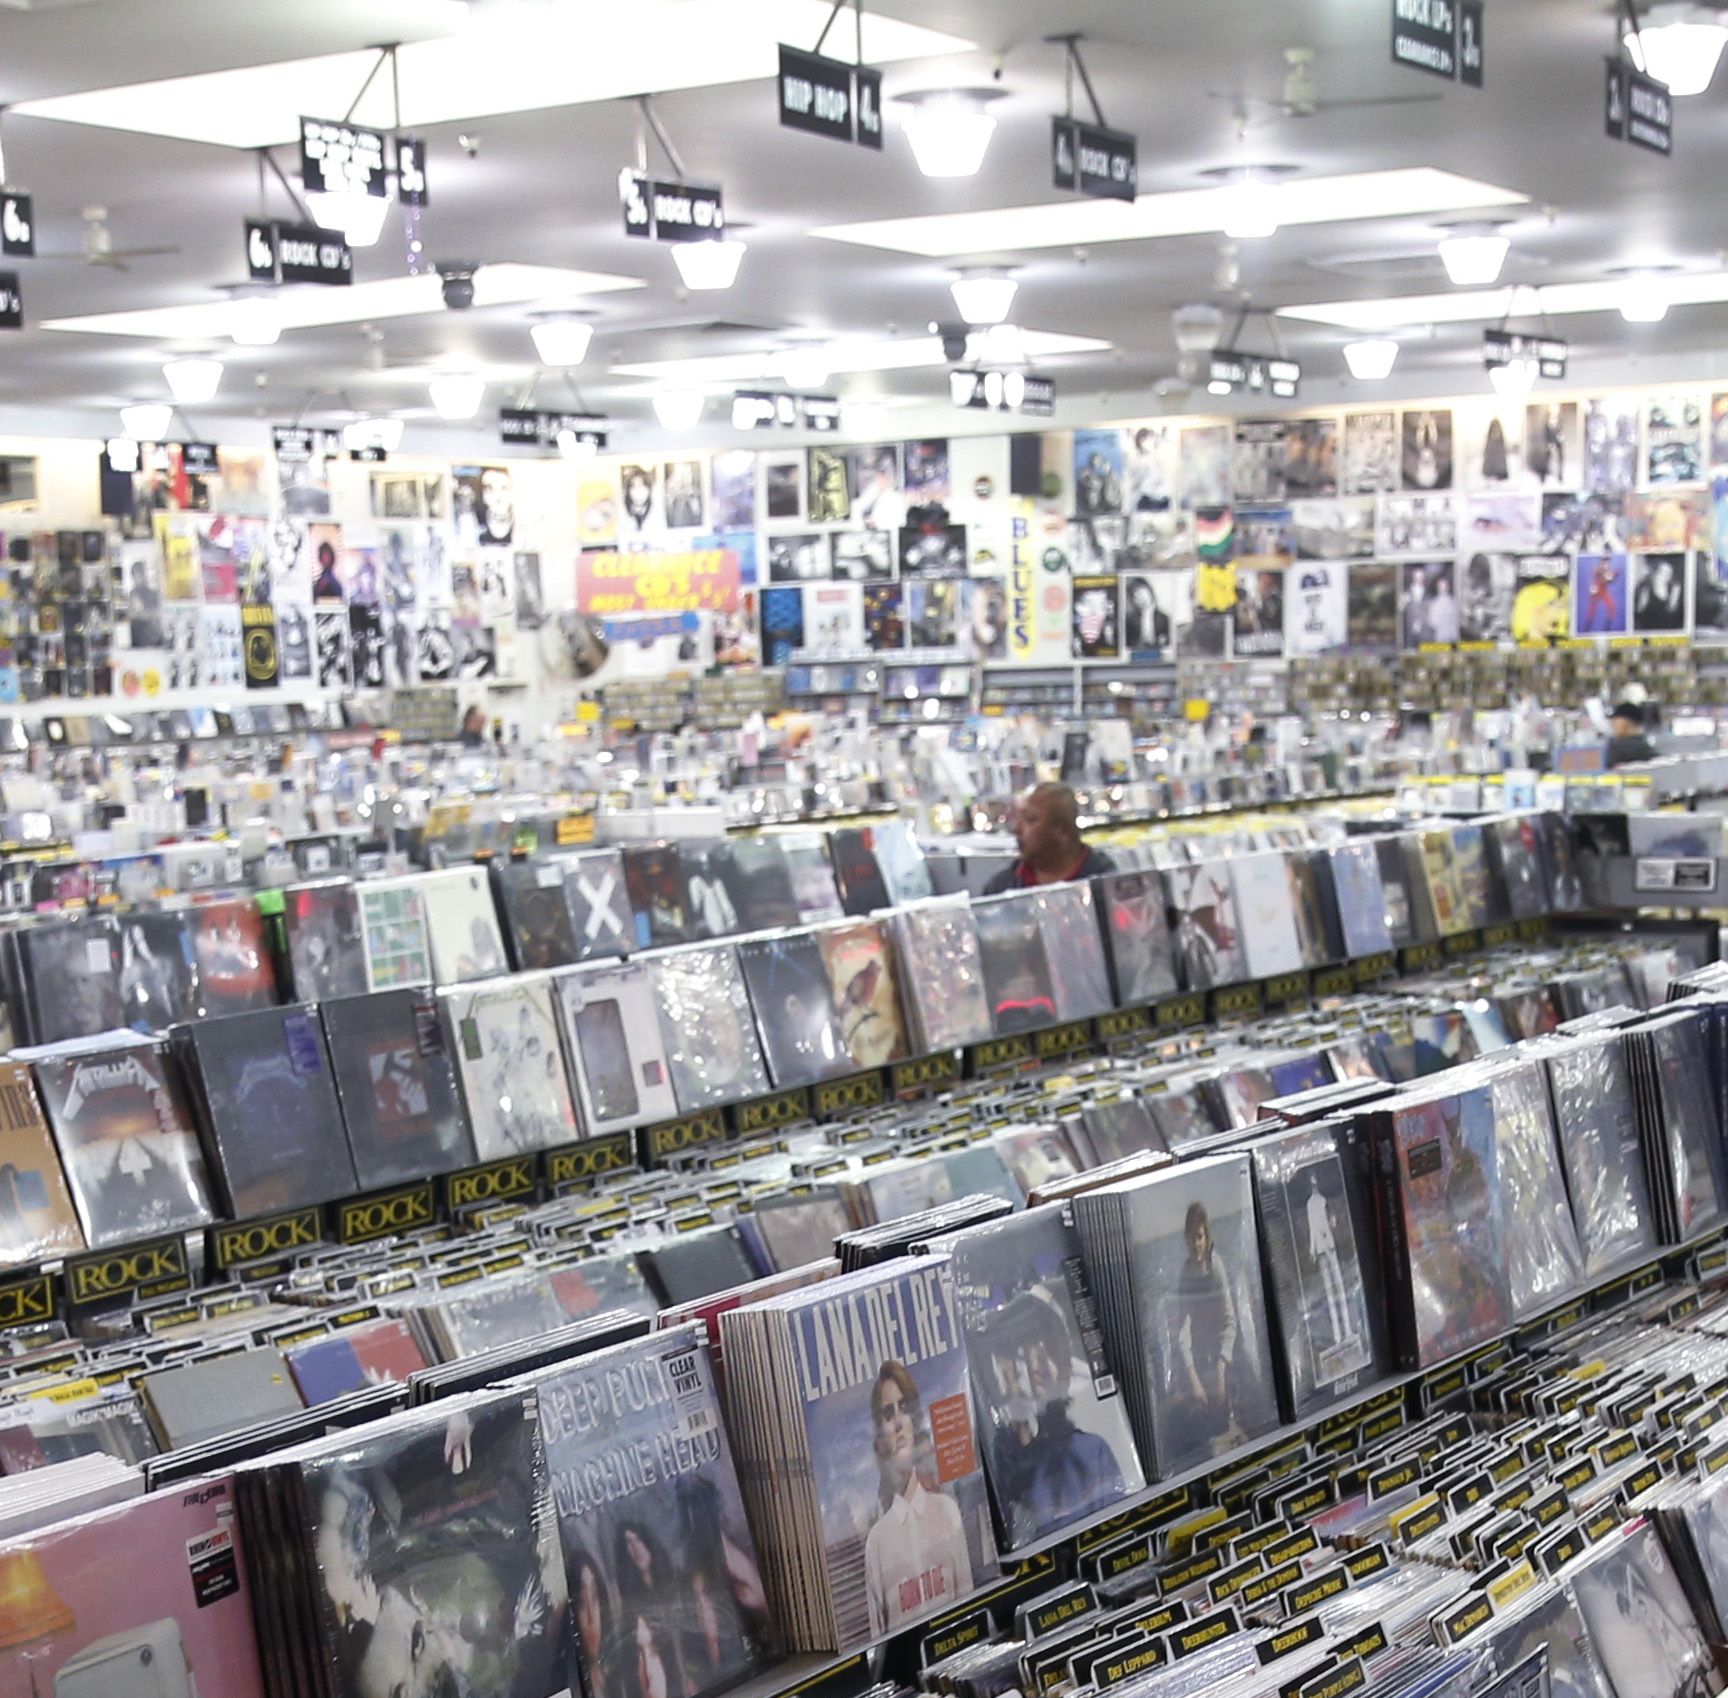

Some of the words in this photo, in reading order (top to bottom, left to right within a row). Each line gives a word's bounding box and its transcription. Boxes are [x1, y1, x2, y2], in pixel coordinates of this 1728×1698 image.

[783, 76, 813, 111] HIP
[814, 88, 848, 123] HOP
[279, 236, 319, 267] ROCK
[1010, 516, 1031, 649] BLUES
[976, 1040, 1029, 1066] ROCK
[1037, 1024, 1088, 1051] ROCK
[894, 1059, 954, 1087] ROCK
[820, 1079, 879, 1109] ROCK
[743, 1099, 806, 1130] ROCK
[655, 1117, 723, 1151] ROCK
[552, 1140, 628, 1178] ROCK
[452, 1164, 530, 1203] ROCK
[345, 1193, 429, 1239] ROCK
[221, 1214, 316, 1261] ROCK
[76, 1247, 181, 1297] ROCK
[794, 1289, 873, 1402] LANA
[866, 1268, 921, 1377] DEL
[912, 1264, 962, 1362] REY
[668, 1356, 697, 1380] CLEAR
[674, 1371, 703, 1395] VINYL
[550, 1436, 657, 1519] MACHINE
[656, 1424, 722, 1480] HEAD
[1295, 1586, 1323, 1610] DEPECHE
[1322, 1578, 1343, 1598] MODE
[1038, 1612, 1056, 1629] LANA
[1055, 1605, 1071, 1622] DEL
[1070, 1597, 1088, 1615] REY
[934, 1635, 958, 1657] DELTA
[957, 1624, 980, 1646] SPIRIT
[1181, 1620, 1229, 1651] DEERHUNTER
[1106, 1664, 1123, 1683] DEF
[1121, 1649, 1158, 1676] LEPPARD
